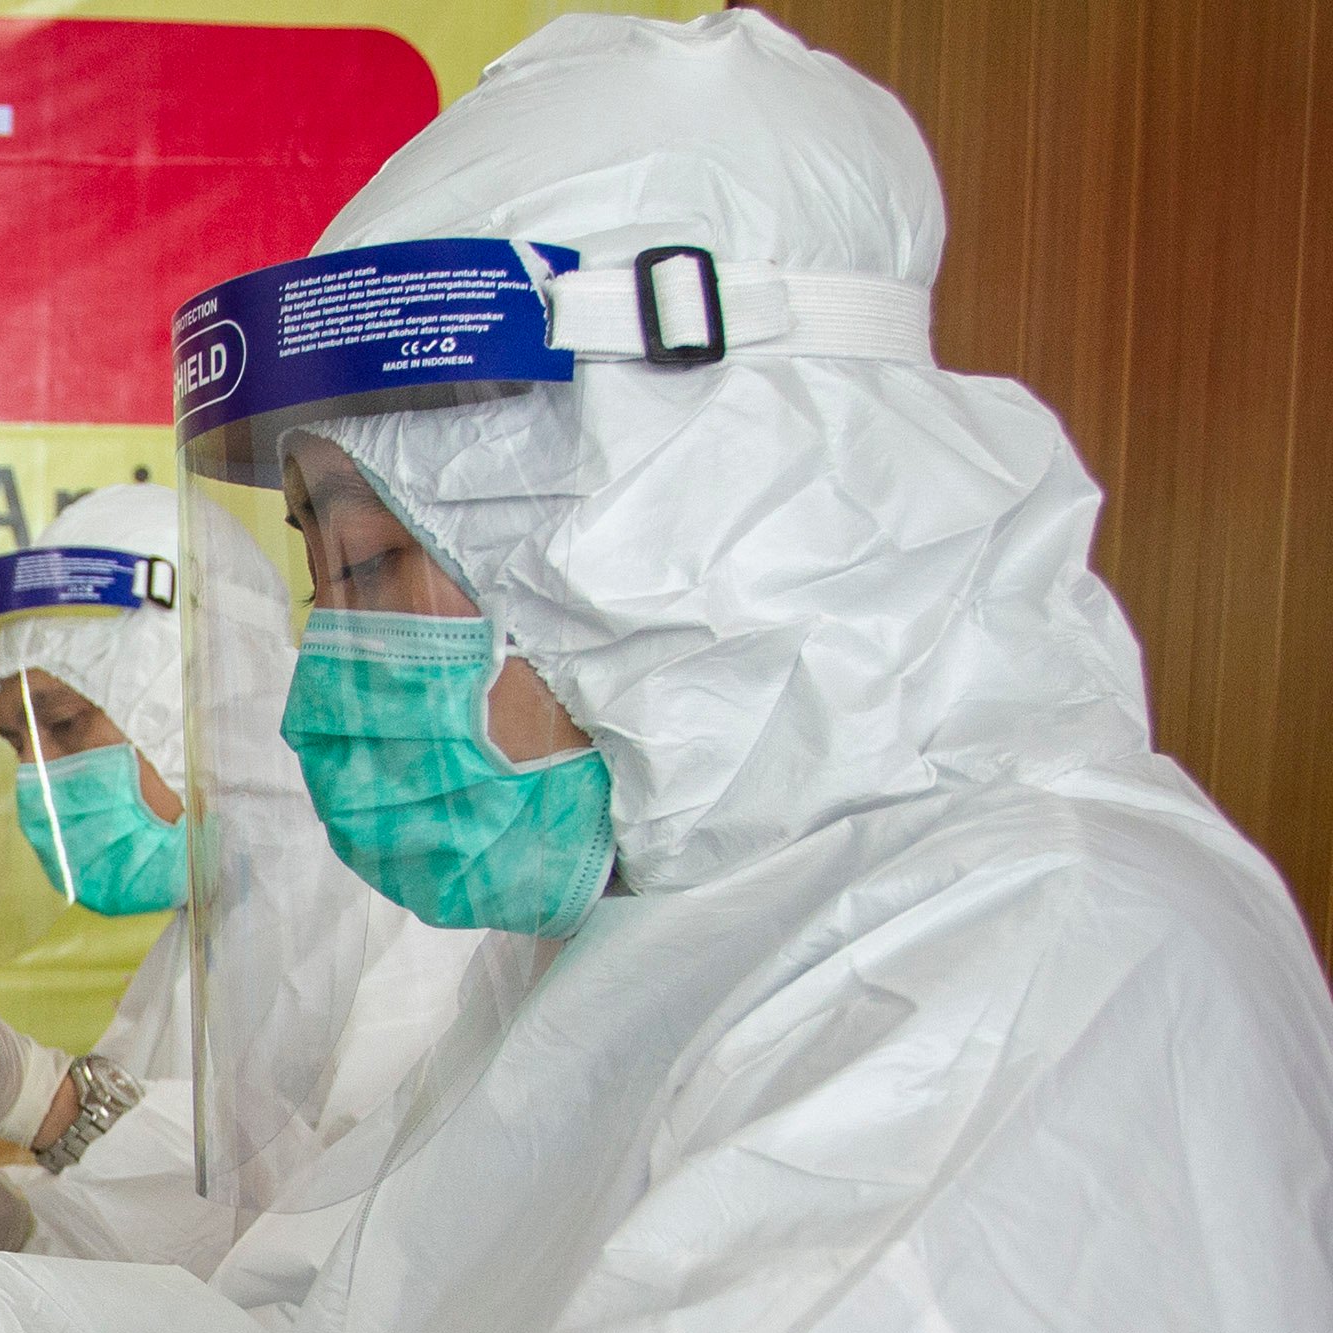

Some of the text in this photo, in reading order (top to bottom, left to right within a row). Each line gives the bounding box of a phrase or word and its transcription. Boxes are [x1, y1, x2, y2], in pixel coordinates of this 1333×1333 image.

[300, 276, 321, 288] kabut
[321, 273, 337, 284] dan
[337, 269, 353, 281] anti
[308, 287, 323, 297] non
[347, 280, 363, 290] dan
[364, 277, 381, 287] non
[452, 268, 479, 278] untuk
[480, 268, 508, 280] wajah
[347, 290, 365, 301] atau
[366, 285, 403, 298] benturan
[404, 283, 427, 295] yang
[427, 280, 496, 292] mengakibatkan
[497, 280, 529, 291] perisai
[446, 290, 496, 302] pemakaian
[324, 315, 354, 327] dengan
[354, 310, 379, 322] super
[379, 307, 401, 318] clear
[405, 315, 438, 327] dengan
[439, 312, 505, 323] menggunakan
[344, 335, 360, 345] dan
[387, 327, 418, 339] alkohol
[419, 325, 439, 335] atau
[174, 342, 228, 400] HIELD
[382, 355, 474, 372] MADE IN INDONESIA
